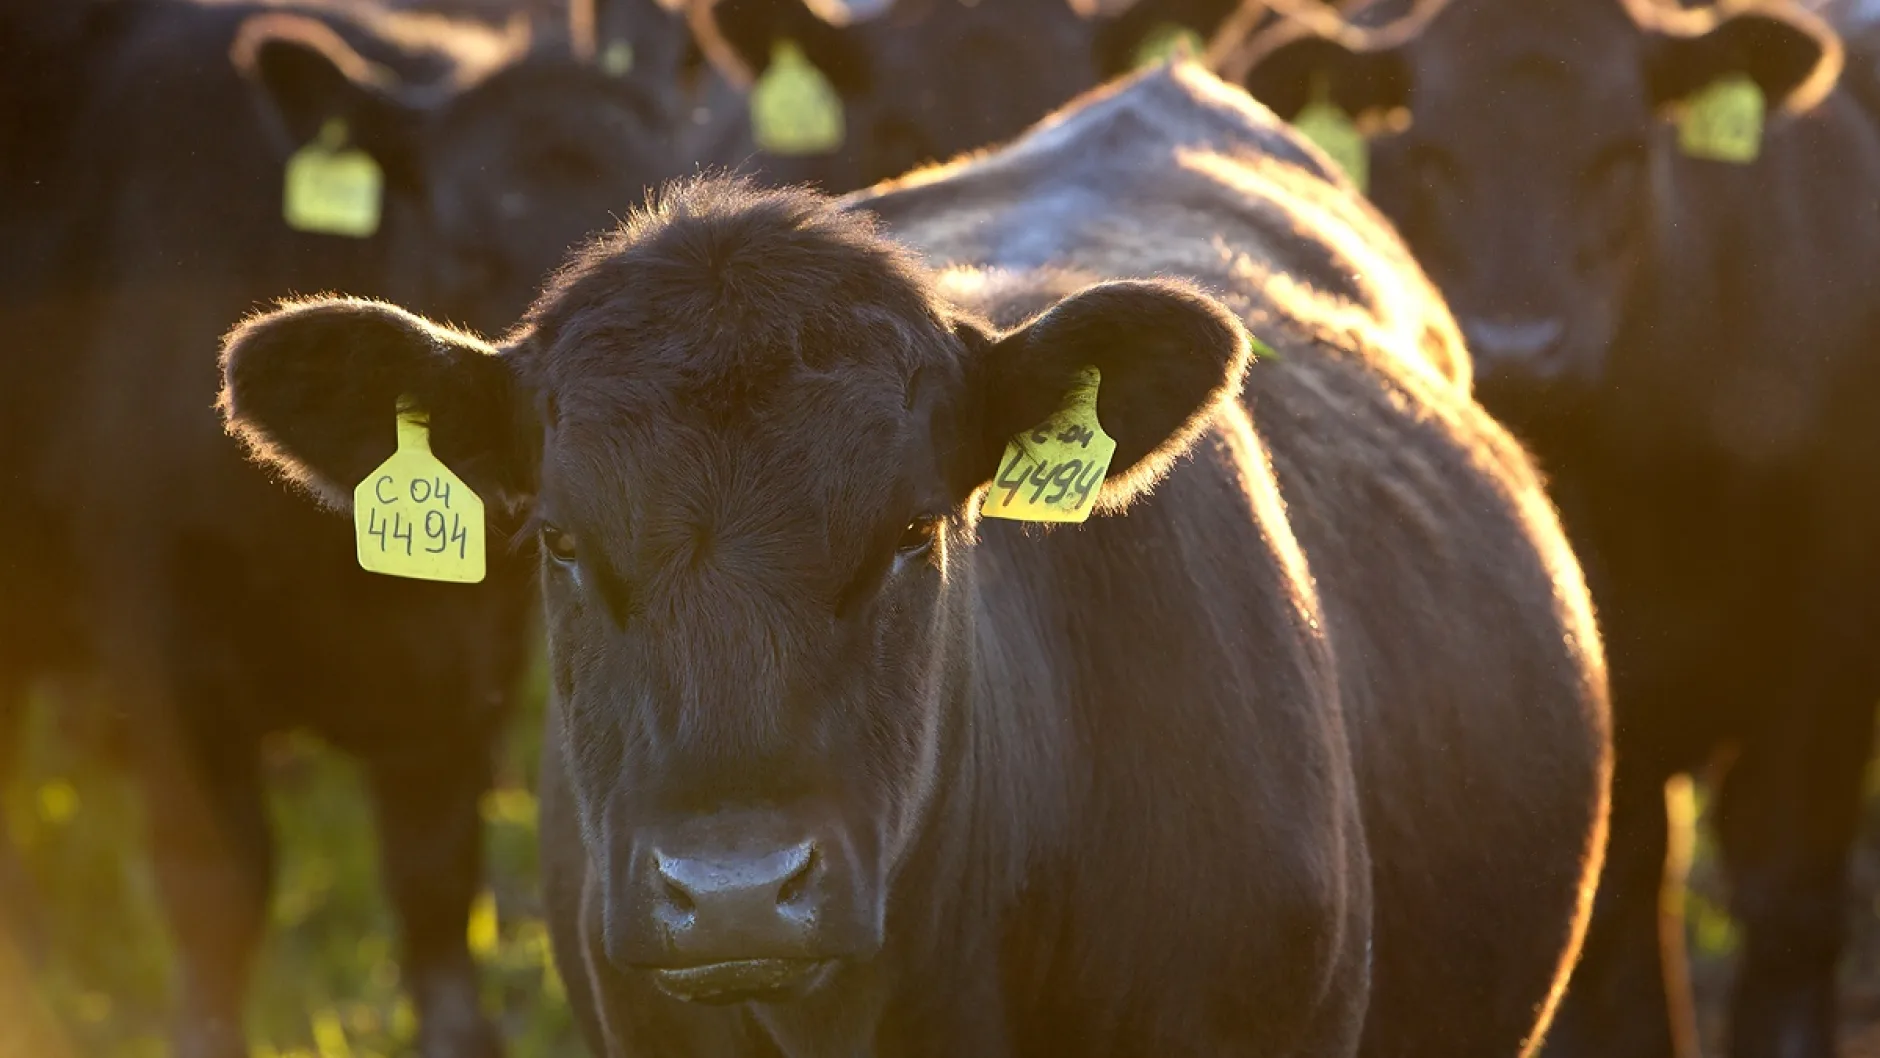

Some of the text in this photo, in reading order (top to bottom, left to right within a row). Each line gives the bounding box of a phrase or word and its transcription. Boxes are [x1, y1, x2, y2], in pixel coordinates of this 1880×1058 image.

[375, 475, 450, 509] C 04
[997, 449, 1105, 511] 4494
[368, 507, 467, 560] 4494
